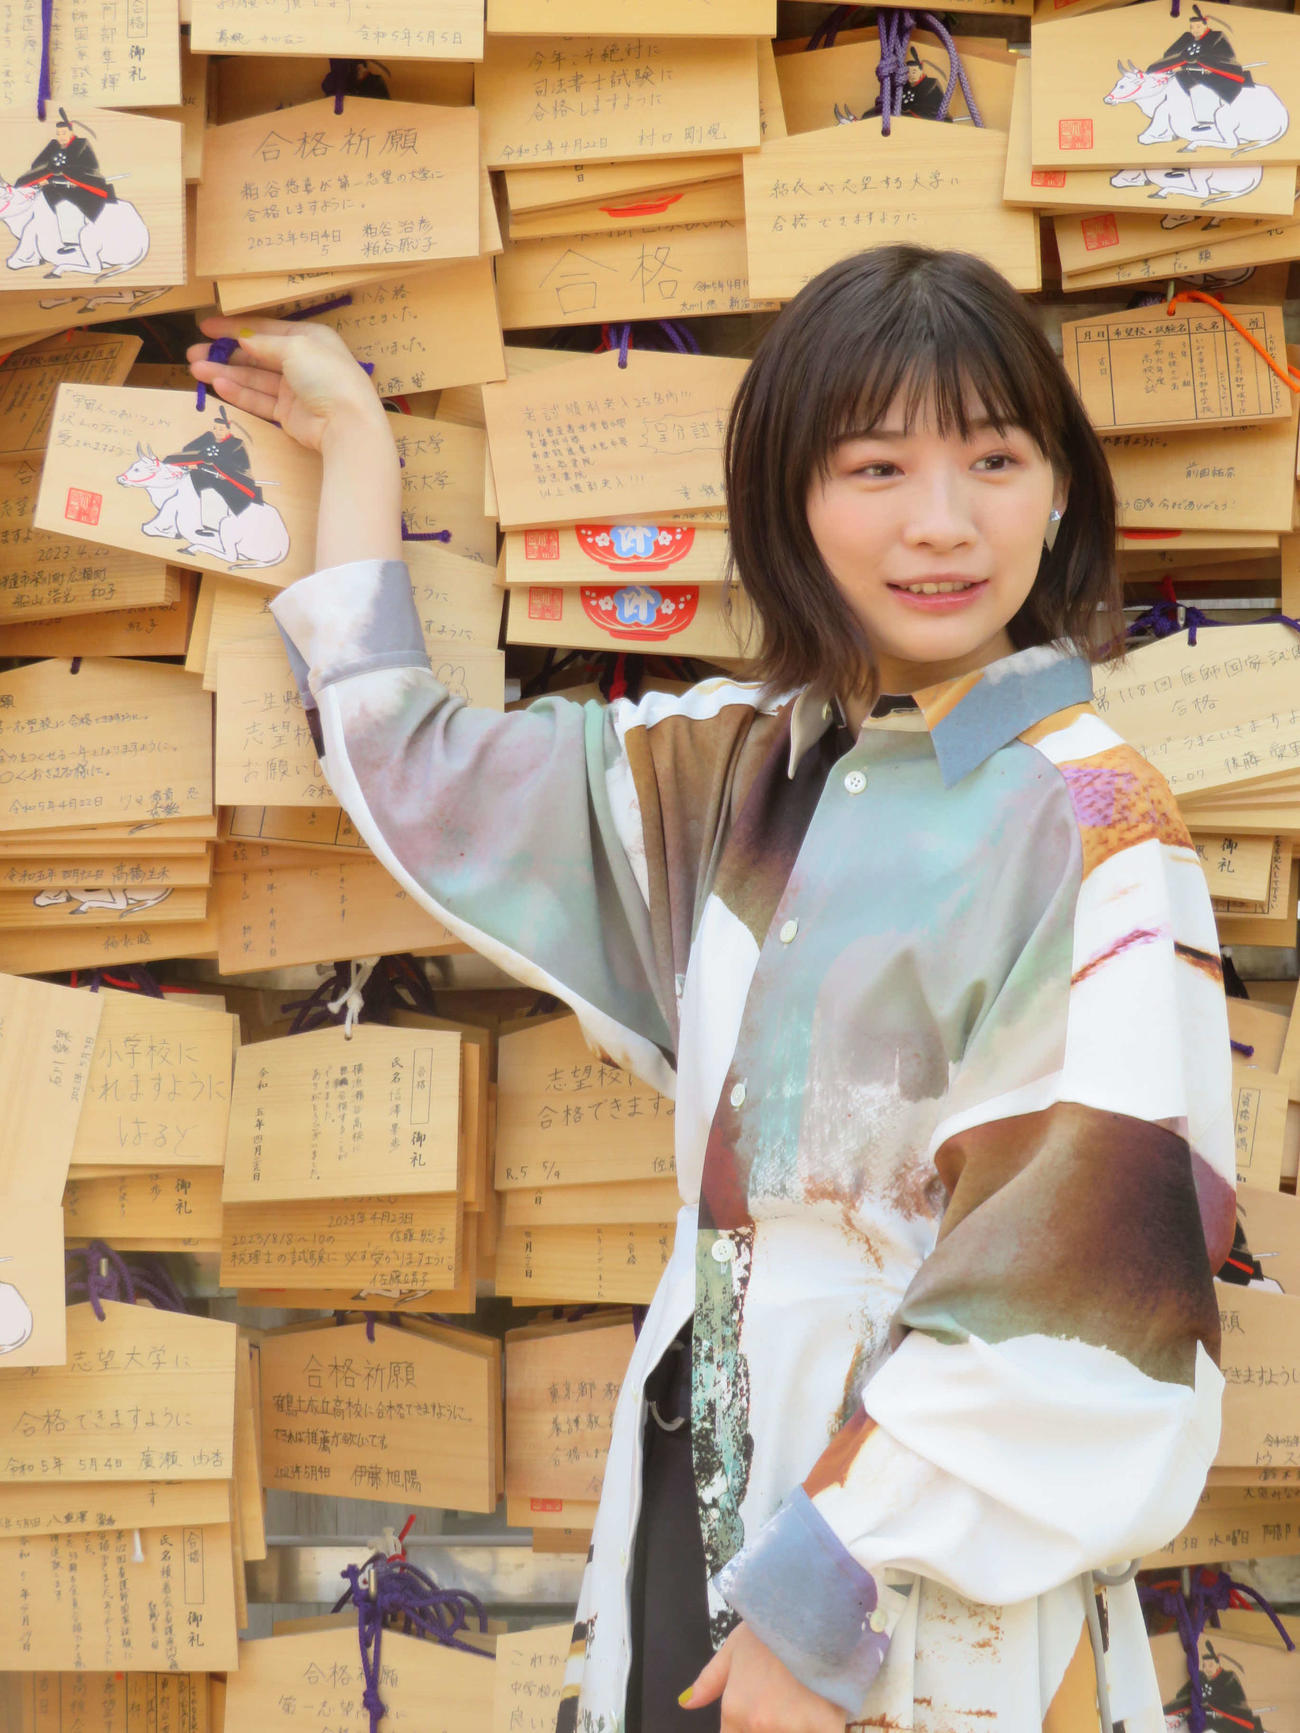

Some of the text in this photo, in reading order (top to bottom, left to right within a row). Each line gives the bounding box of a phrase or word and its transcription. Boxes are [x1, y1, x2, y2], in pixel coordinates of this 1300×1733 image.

[129, 44, 147, 82] 御礼
[252, 127, 420, 163] 合格祈願
[538, 243, 684, 315] 合格
[1217, 837, 1238, 874] 御礼
[99, 1033, 200, 1072] 小学校に
[545, 1064, 633, 1093] 志望校
[410, 1130, 427, 1168] 御礼
[174, 1177, 193, 1215] 御礼
[71, 1345, 192, 1372] 志望大学に
[302, 1353, 418, 1393] 合格祈願
[12, 1404, 193, 1438] 合格できますように
[187, 1610, 205, 1648] 御礼
